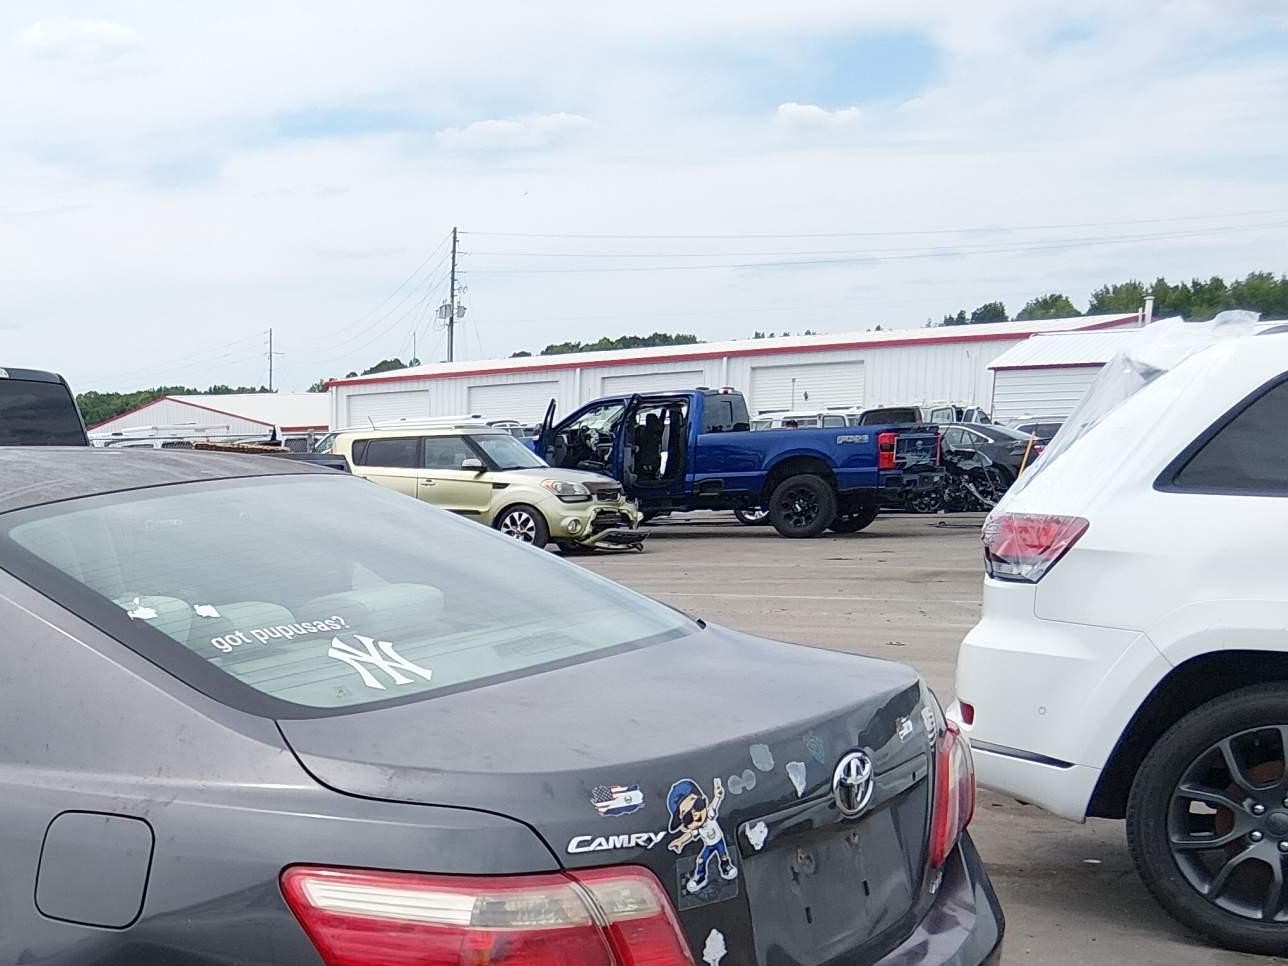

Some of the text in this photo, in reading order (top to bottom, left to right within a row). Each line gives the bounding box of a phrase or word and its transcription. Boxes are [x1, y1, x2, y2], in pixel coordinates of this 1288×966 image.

[211, 615, 350, 653] got pupusas?
[567, 831, 667, 853] CAMRY
